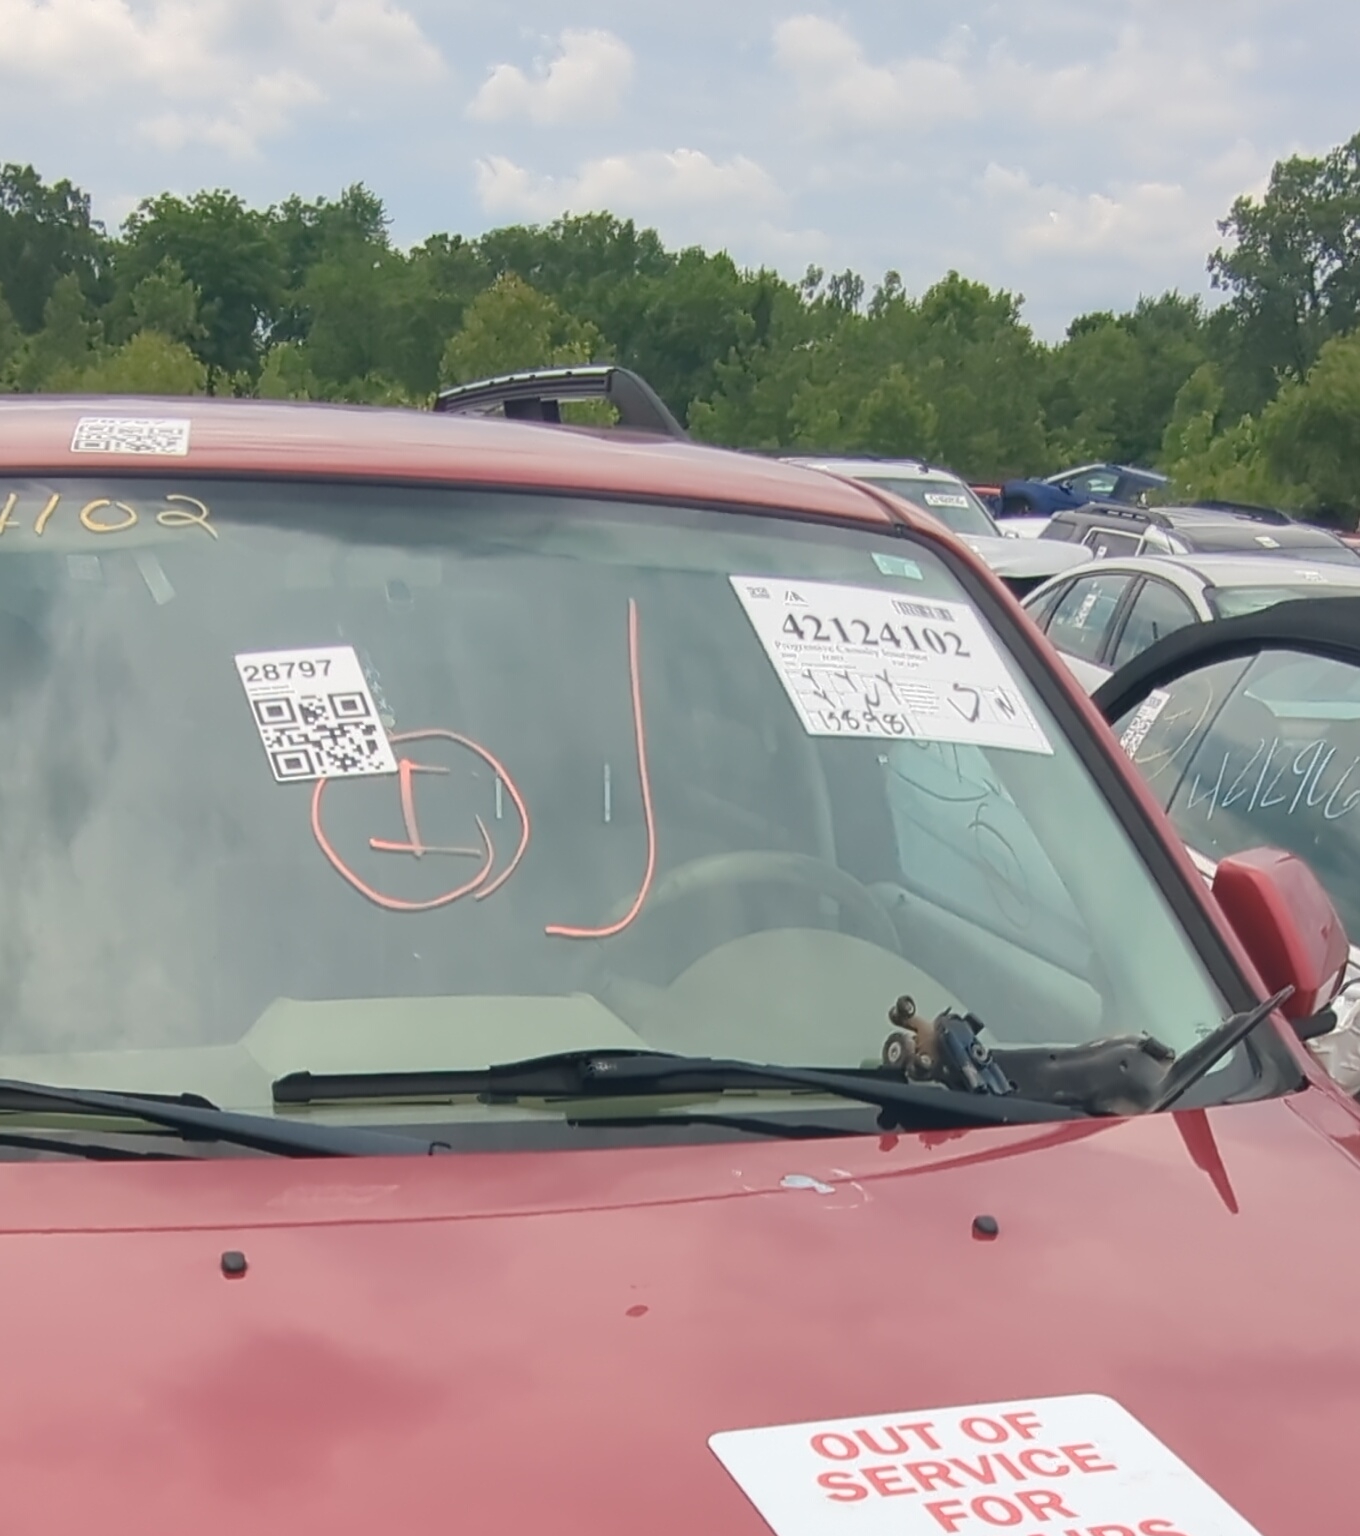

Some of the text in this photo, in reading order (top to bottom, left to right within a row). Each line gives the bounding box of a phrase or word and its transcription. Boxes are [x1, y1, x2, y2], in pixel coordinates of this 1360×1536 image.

[782, 614, 971, 658] 42124102
[243, 659, 332, 683] 28797
[809, 1410, 1045, 1463] OUT OF
[815, 1442, 1118, 1504] SERVICE
[923, 1488, 1080, 1535] FOR
